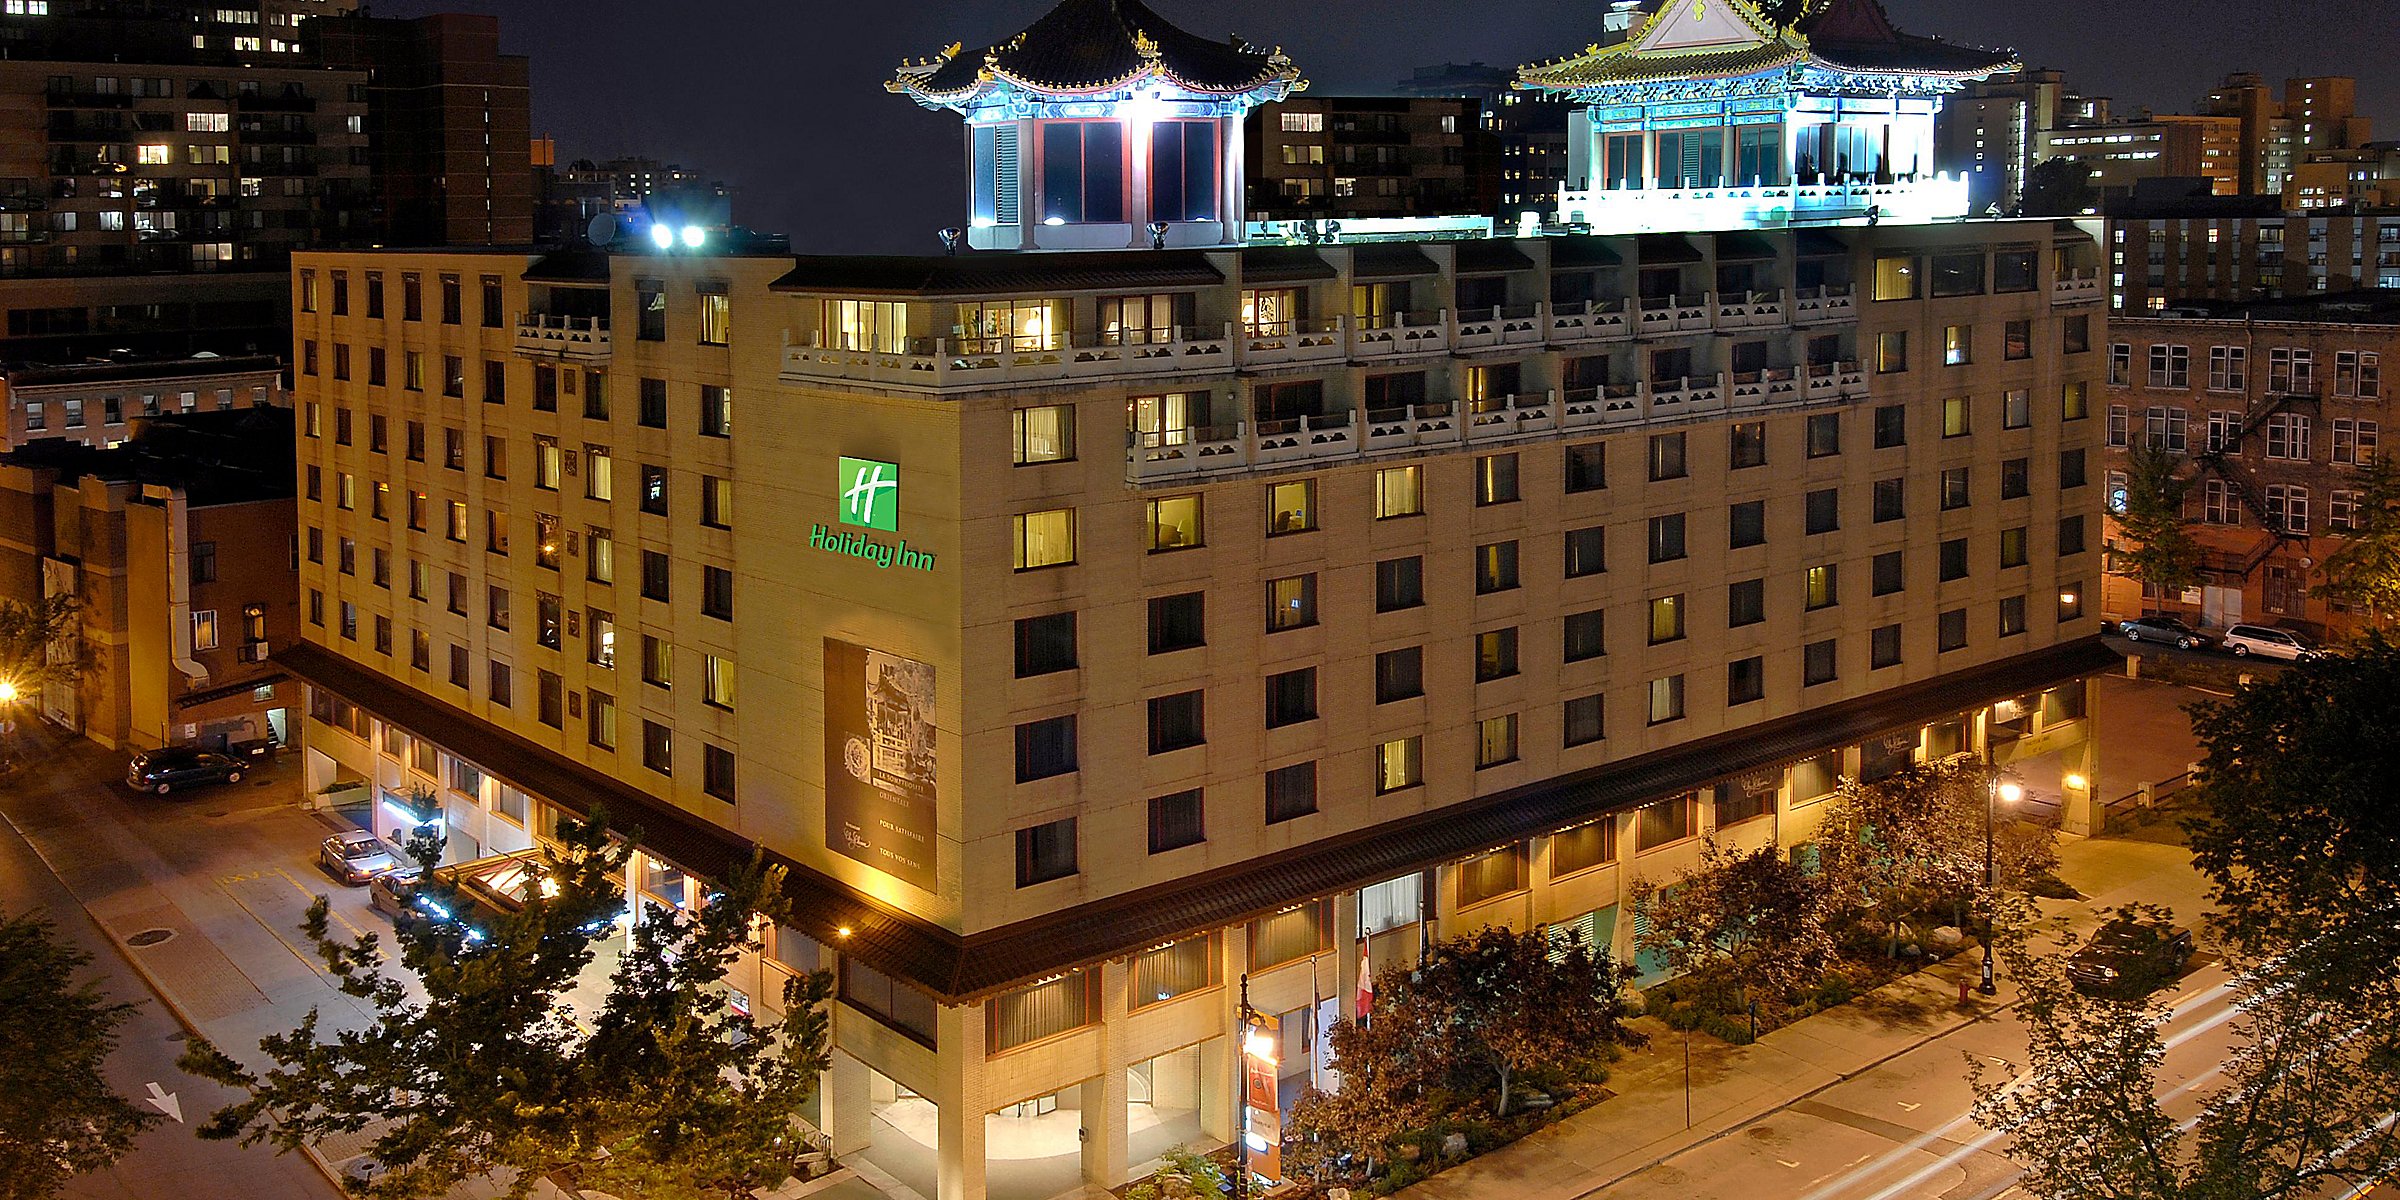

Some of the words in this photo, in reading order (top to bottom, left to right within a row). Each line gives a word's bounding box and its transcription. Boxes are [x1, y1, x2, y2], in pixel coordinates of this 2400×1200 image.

[809, 524, 894, 568] Holiday
[895, 540, 935, 572] Inn
[879, 819, 894, 830] POUR
[879, 847, 894, 859] TOUS
[895, 854, 905, 863] VOS
